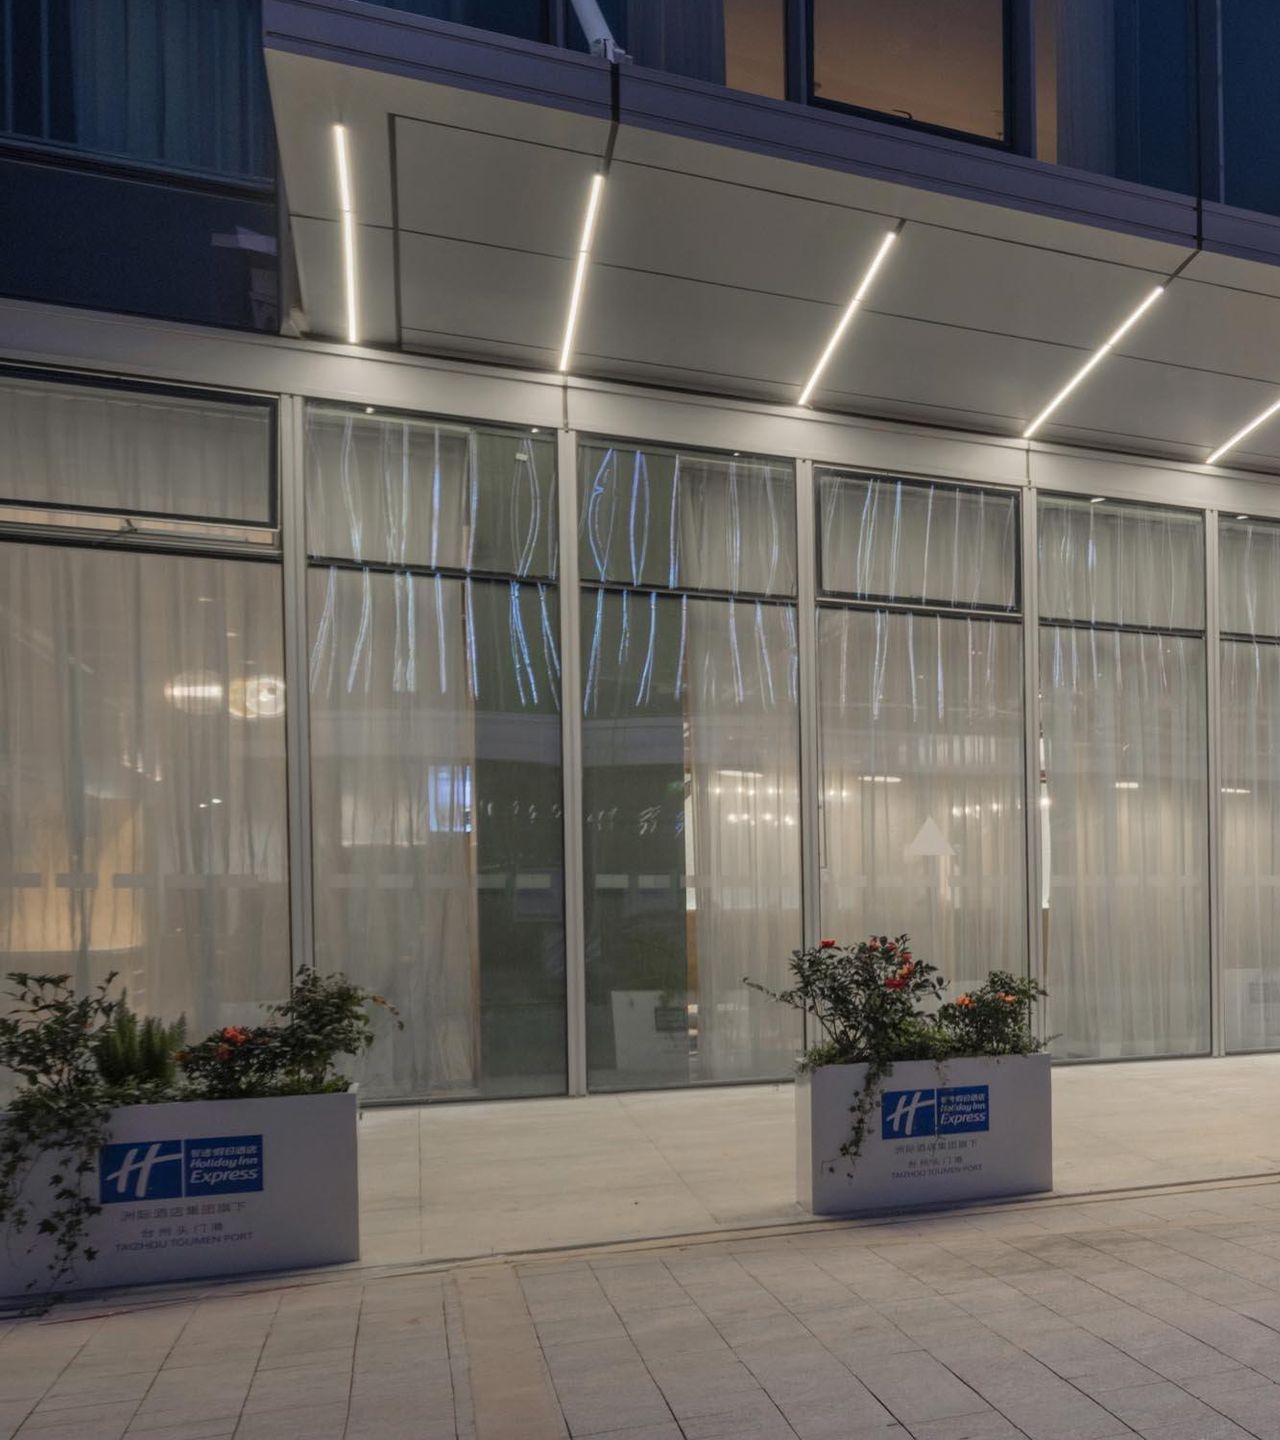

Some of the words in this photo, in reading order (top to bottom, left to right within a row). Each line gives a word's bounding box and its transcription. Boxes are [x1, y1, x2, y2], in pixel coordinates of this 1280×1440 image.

[940, 1111, 987, 1126] Express
[190, 1157, 238, 1169] Holiday
[238, 1156, 258, 1166] Inn
[190, 1168, 259, 1186] Express
[223, 1231, 254, 1244] PORT
